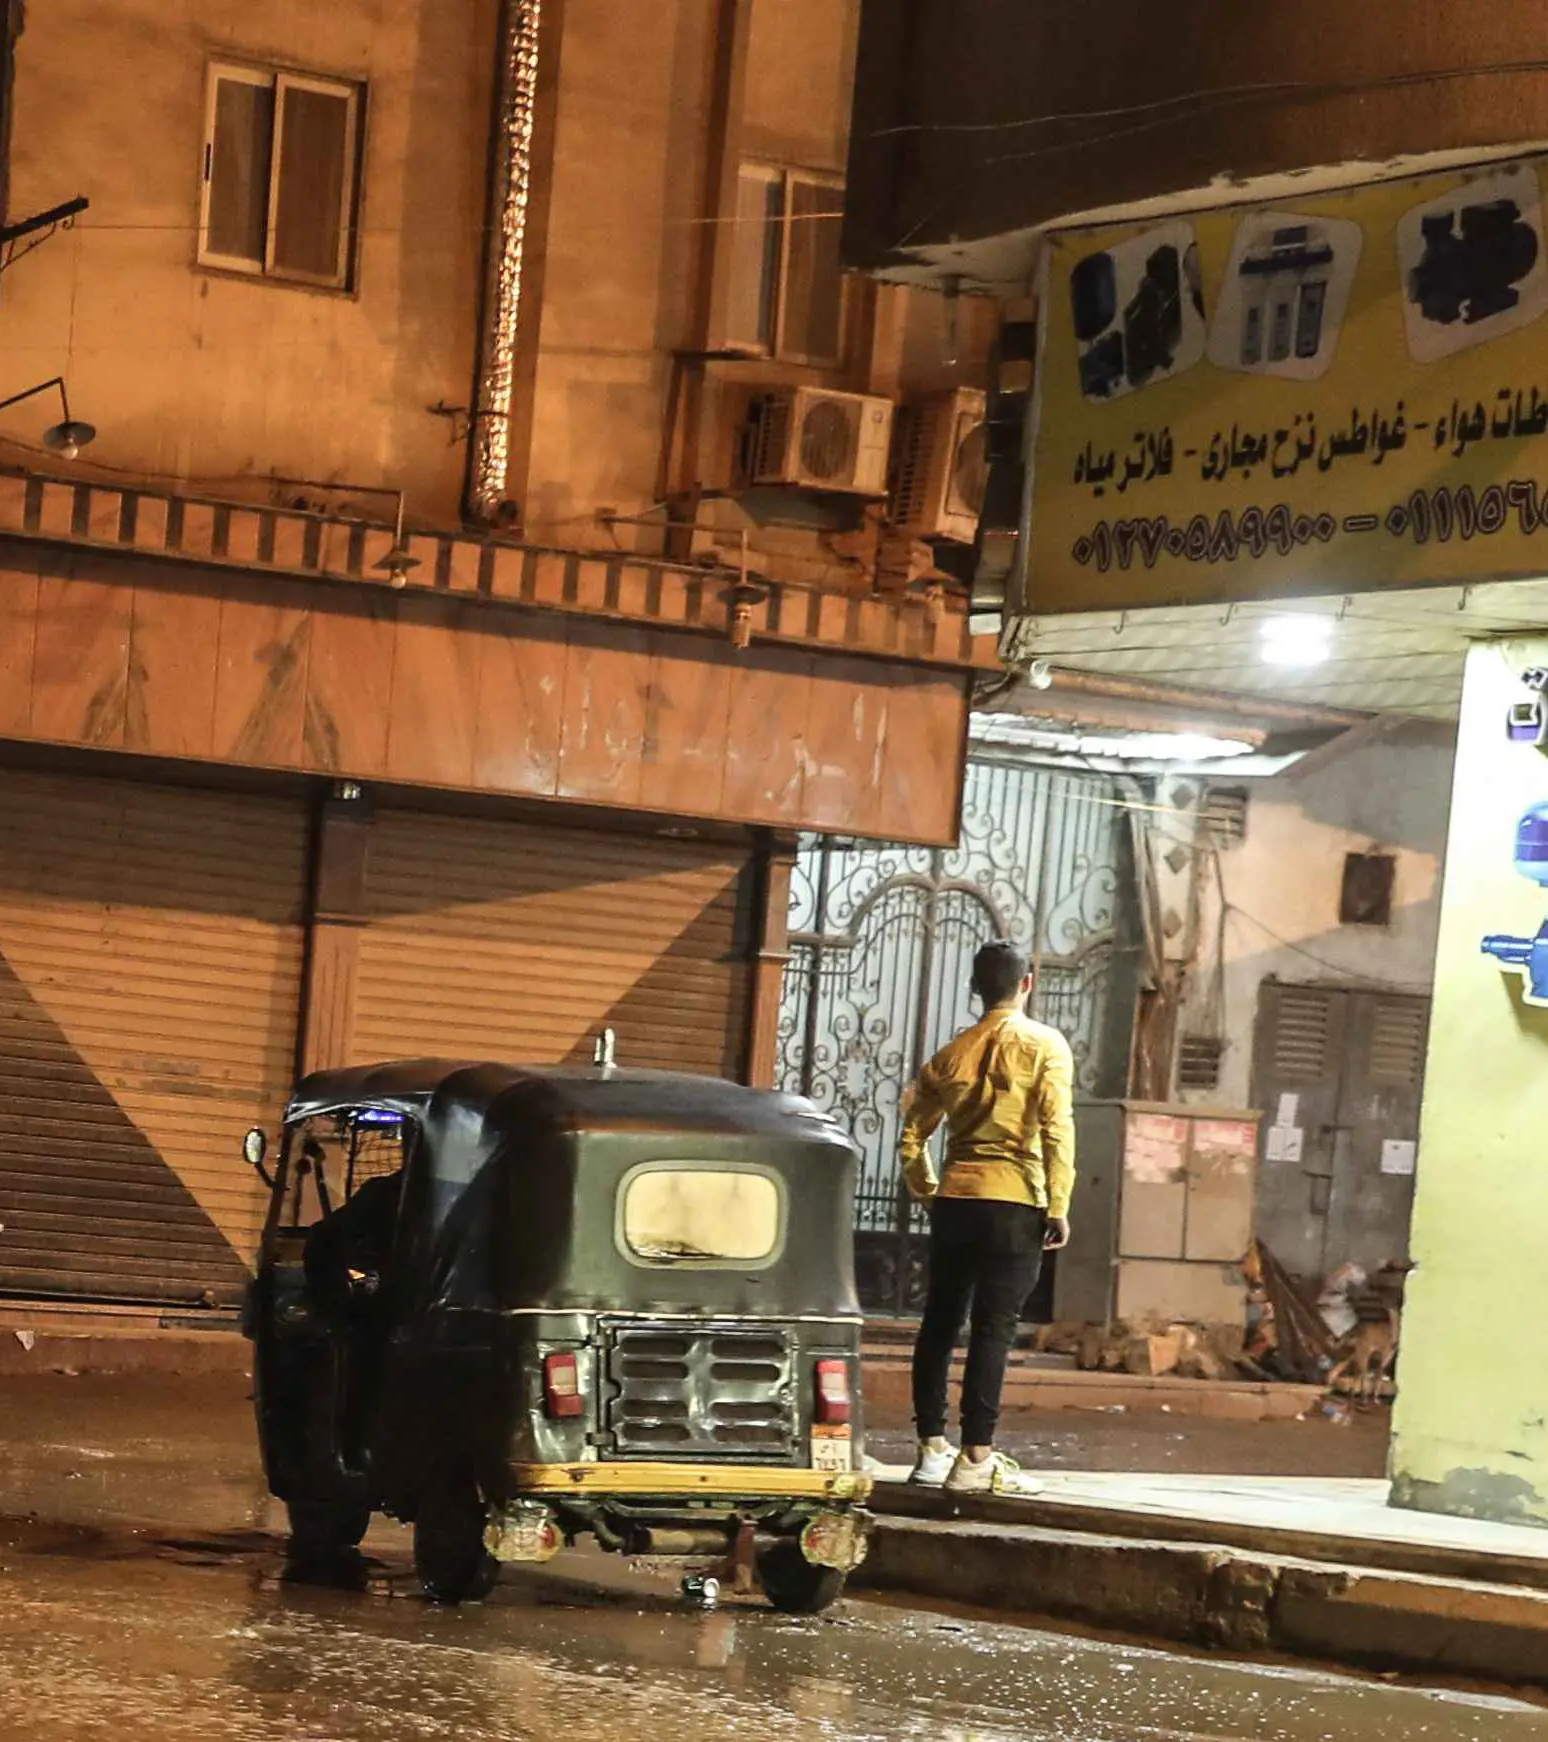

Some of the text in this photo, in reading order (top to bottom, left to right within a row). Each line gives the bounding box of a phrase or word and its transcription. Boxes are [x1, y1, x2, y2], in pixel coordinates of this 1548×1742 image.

[1117, 425, 1173, 492] فلاتر
[1271, 412, 1315, 478] نزح
[1318, 400, 1406, 472] غواطس
[1435, 398, 1486, 458] هواء
[1073, 439, 1115, 497] مياه
[1385, 480, 1548, 544] ٠١١١٥٦
